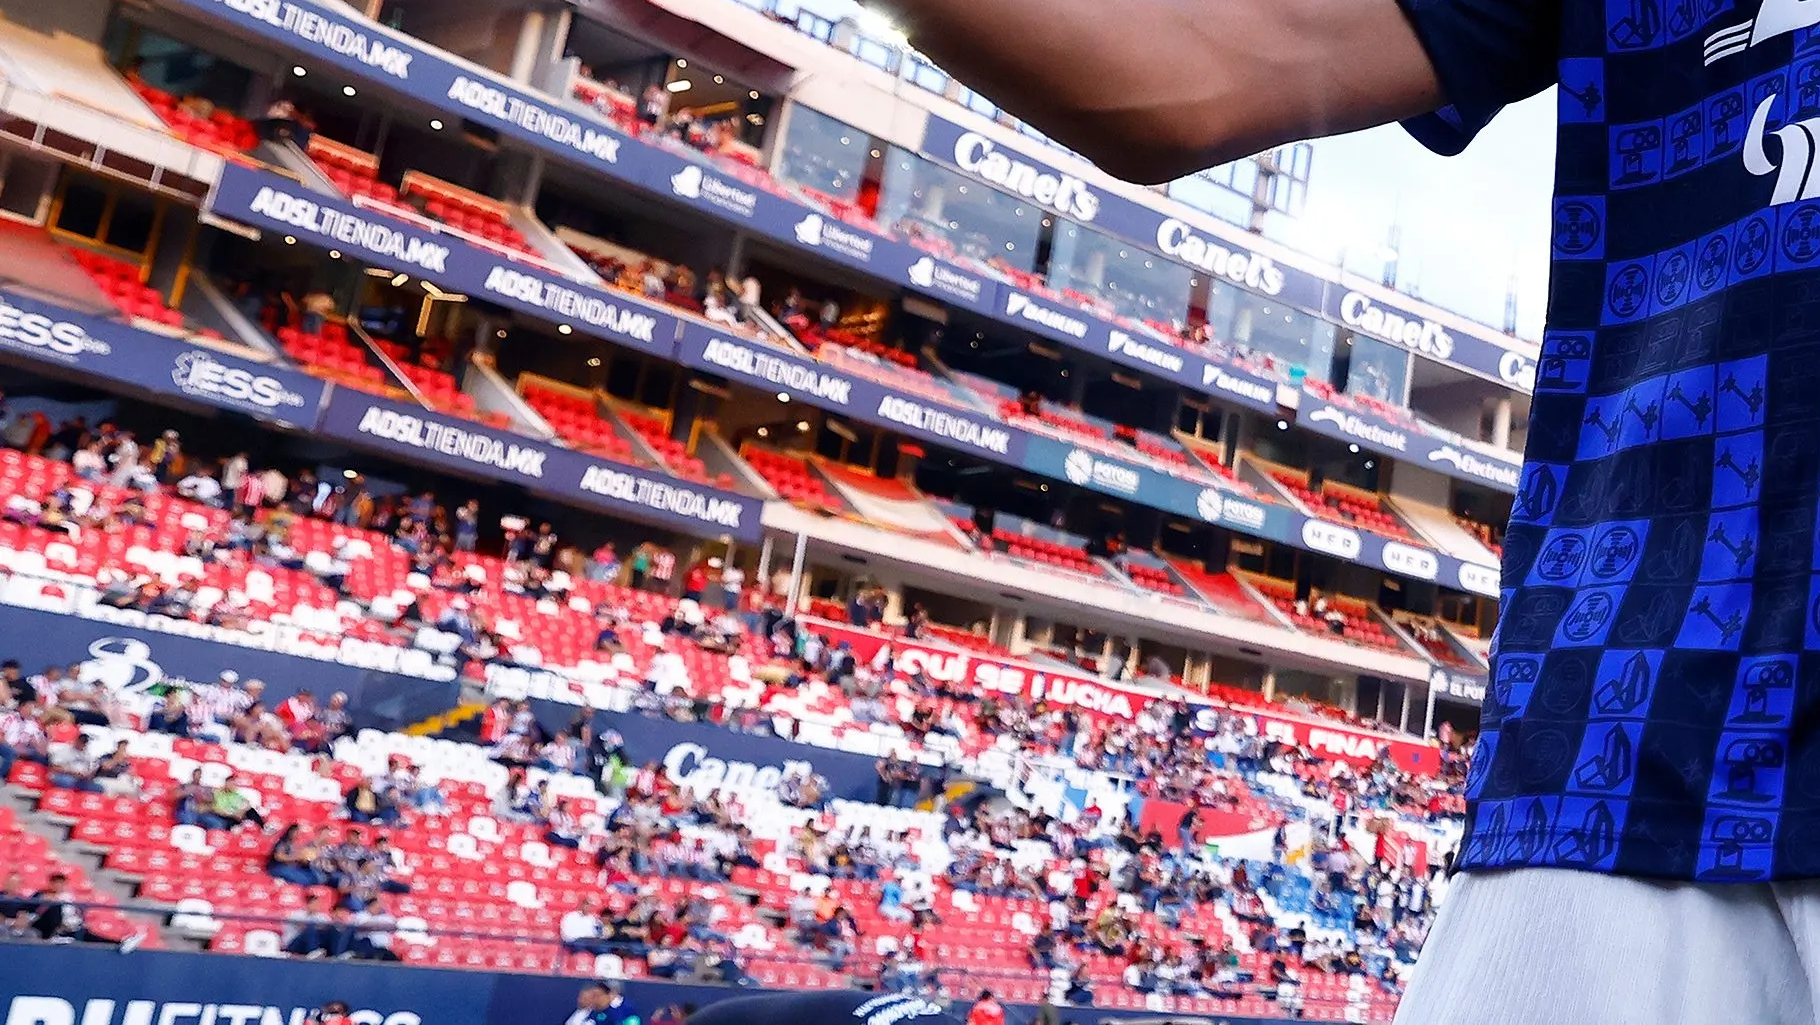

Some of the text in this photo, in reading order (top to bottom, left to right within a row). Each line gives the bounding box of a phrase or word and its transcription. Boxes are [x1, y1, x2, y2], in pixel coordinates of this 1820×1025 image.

[954, 132, 1100, 221] Canel's
[1156, 218, 1285, 296] Canel's
[1340, 290, 1454, 360] Canel's
[1308, 727, 1386, 761] FINA
